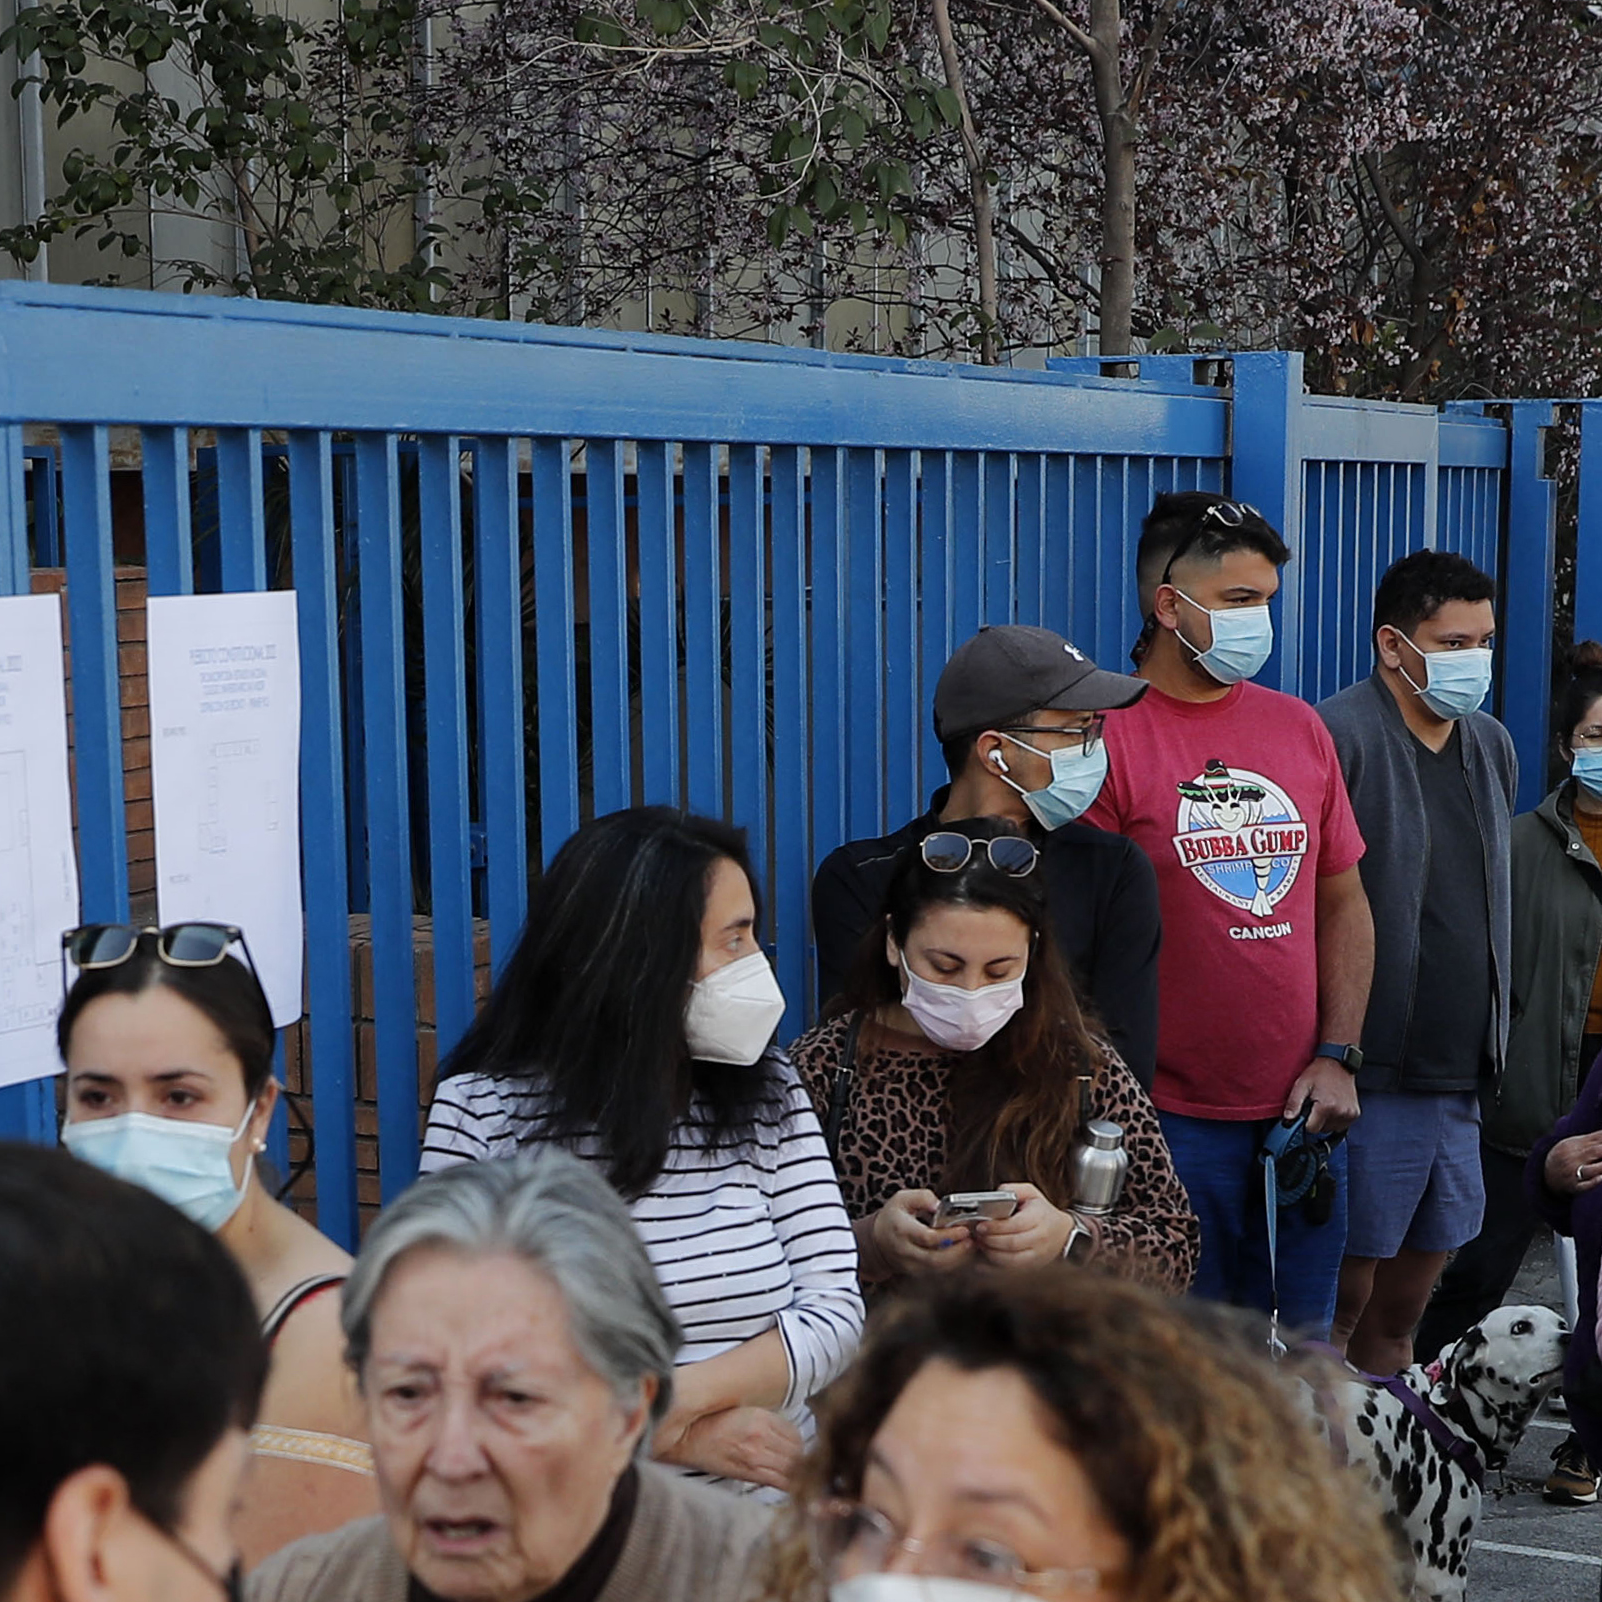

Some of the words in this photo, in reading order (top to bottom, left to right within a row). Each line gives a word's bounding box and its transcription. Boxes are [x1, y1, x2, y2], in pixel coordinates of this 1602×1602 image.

[1179, 831, 1249, 863] BUBBA
[1250, 828, 1306, 854] GUMP
[1207, 860, 1253, 875] SHRIMP
[1193, 866, 1251, 908] RESTAURANT
[1276, 858, 1300, 897] MARKET
[1228, 920, 1293, 940] CANCUN
